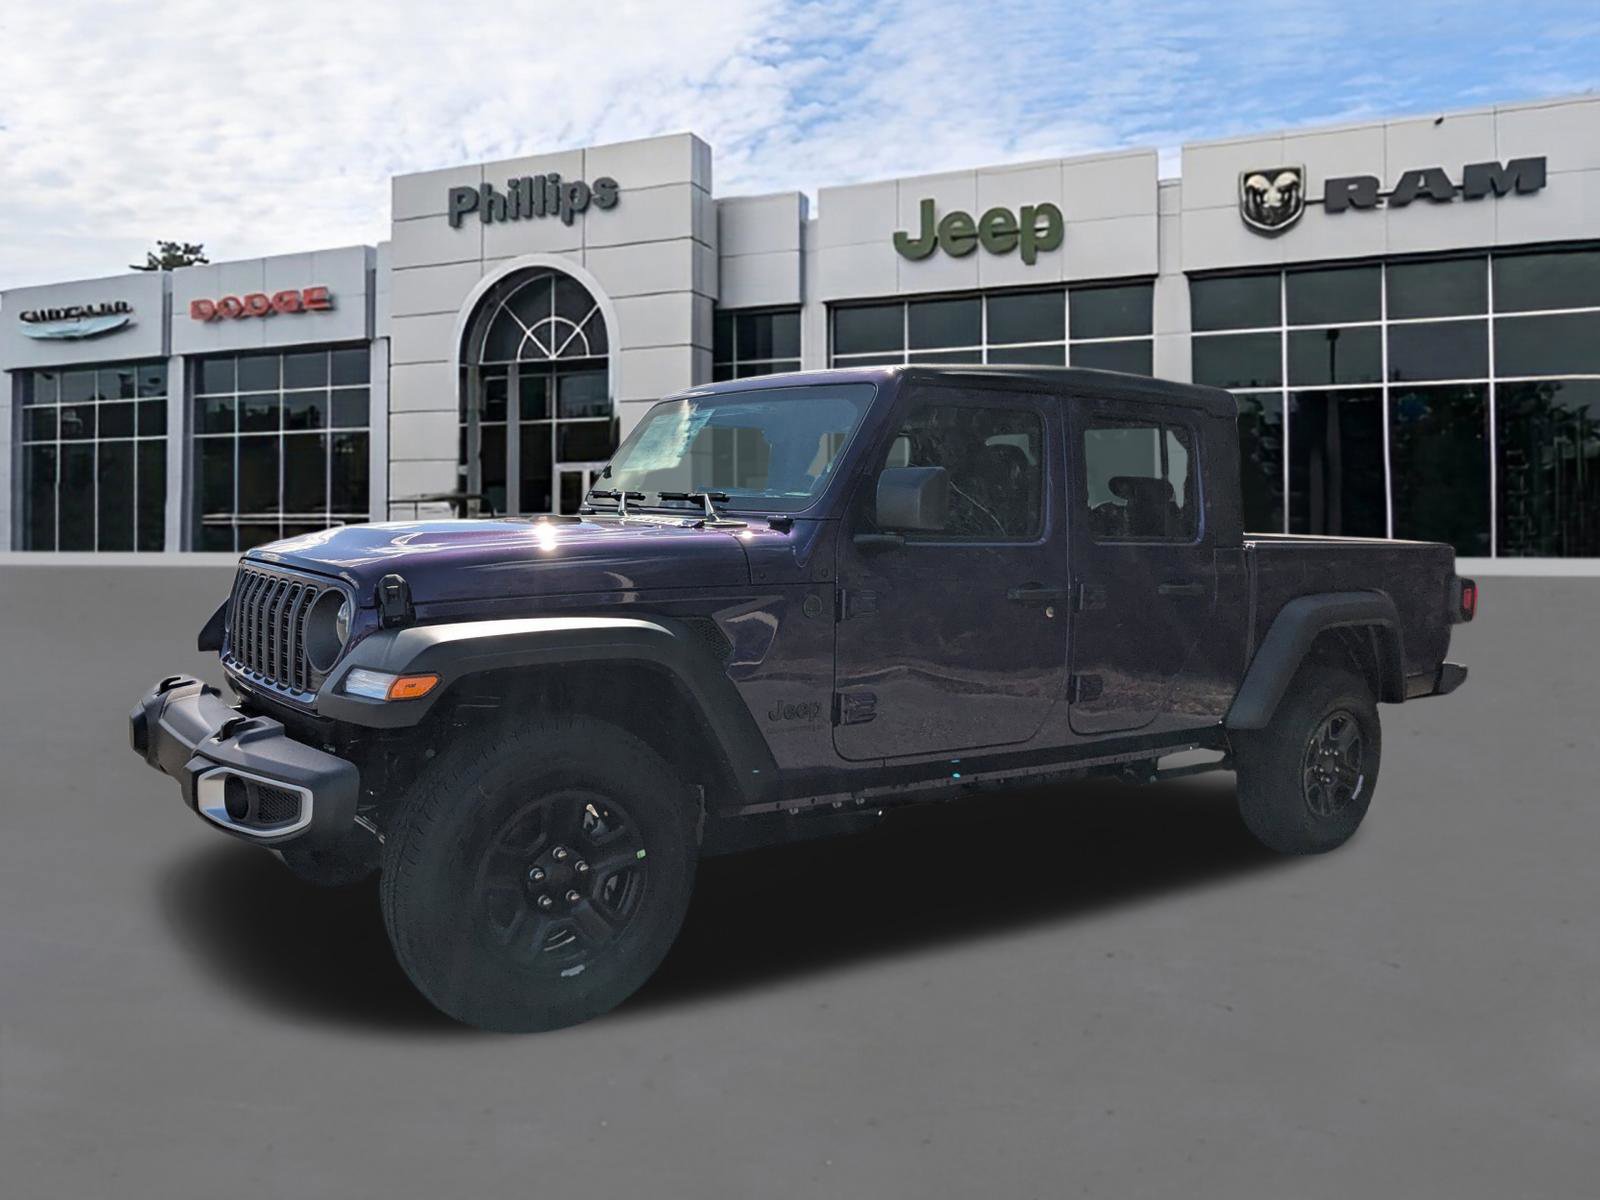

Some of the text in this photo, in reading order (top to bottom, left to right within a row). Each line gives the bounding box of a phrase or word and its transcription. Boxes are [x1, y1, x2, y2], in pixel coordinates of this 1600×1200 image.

[449, 173, 619, 228] Phillips
[1324, 156, 1547, 215] RAM
[893, 198, 1064, 266] Jeep
[191, 286, 332, 321] DODGE
[768, 699, 821, 722] Jeep
